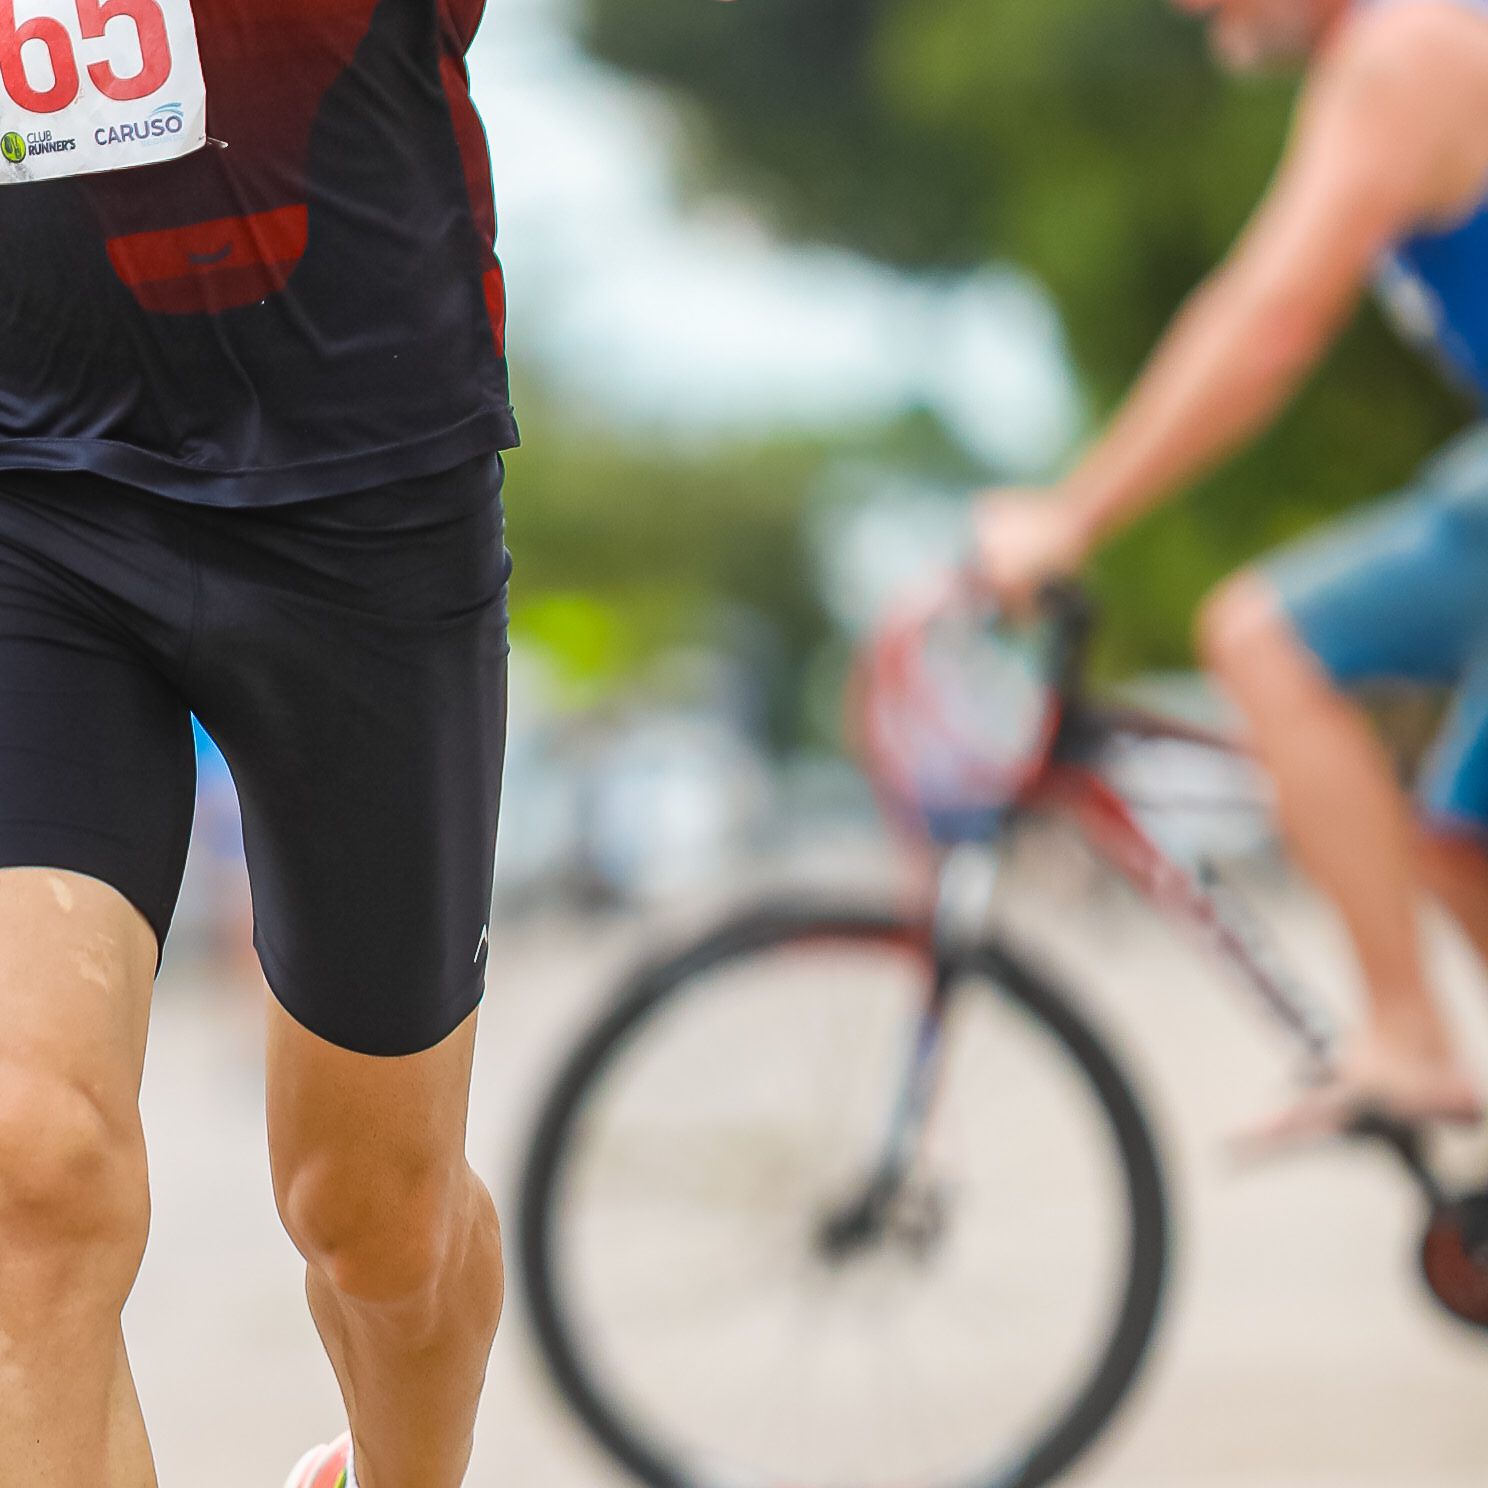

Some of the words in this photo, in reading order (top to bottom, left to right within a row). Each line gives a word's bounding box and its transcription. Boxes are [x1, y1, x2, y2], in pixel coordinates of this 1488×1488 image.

[26, 129, 53, 144] CLUB
[94, 115, 183, 146] CARUSO
[28, 138, 76, 156] RUNNER'S
